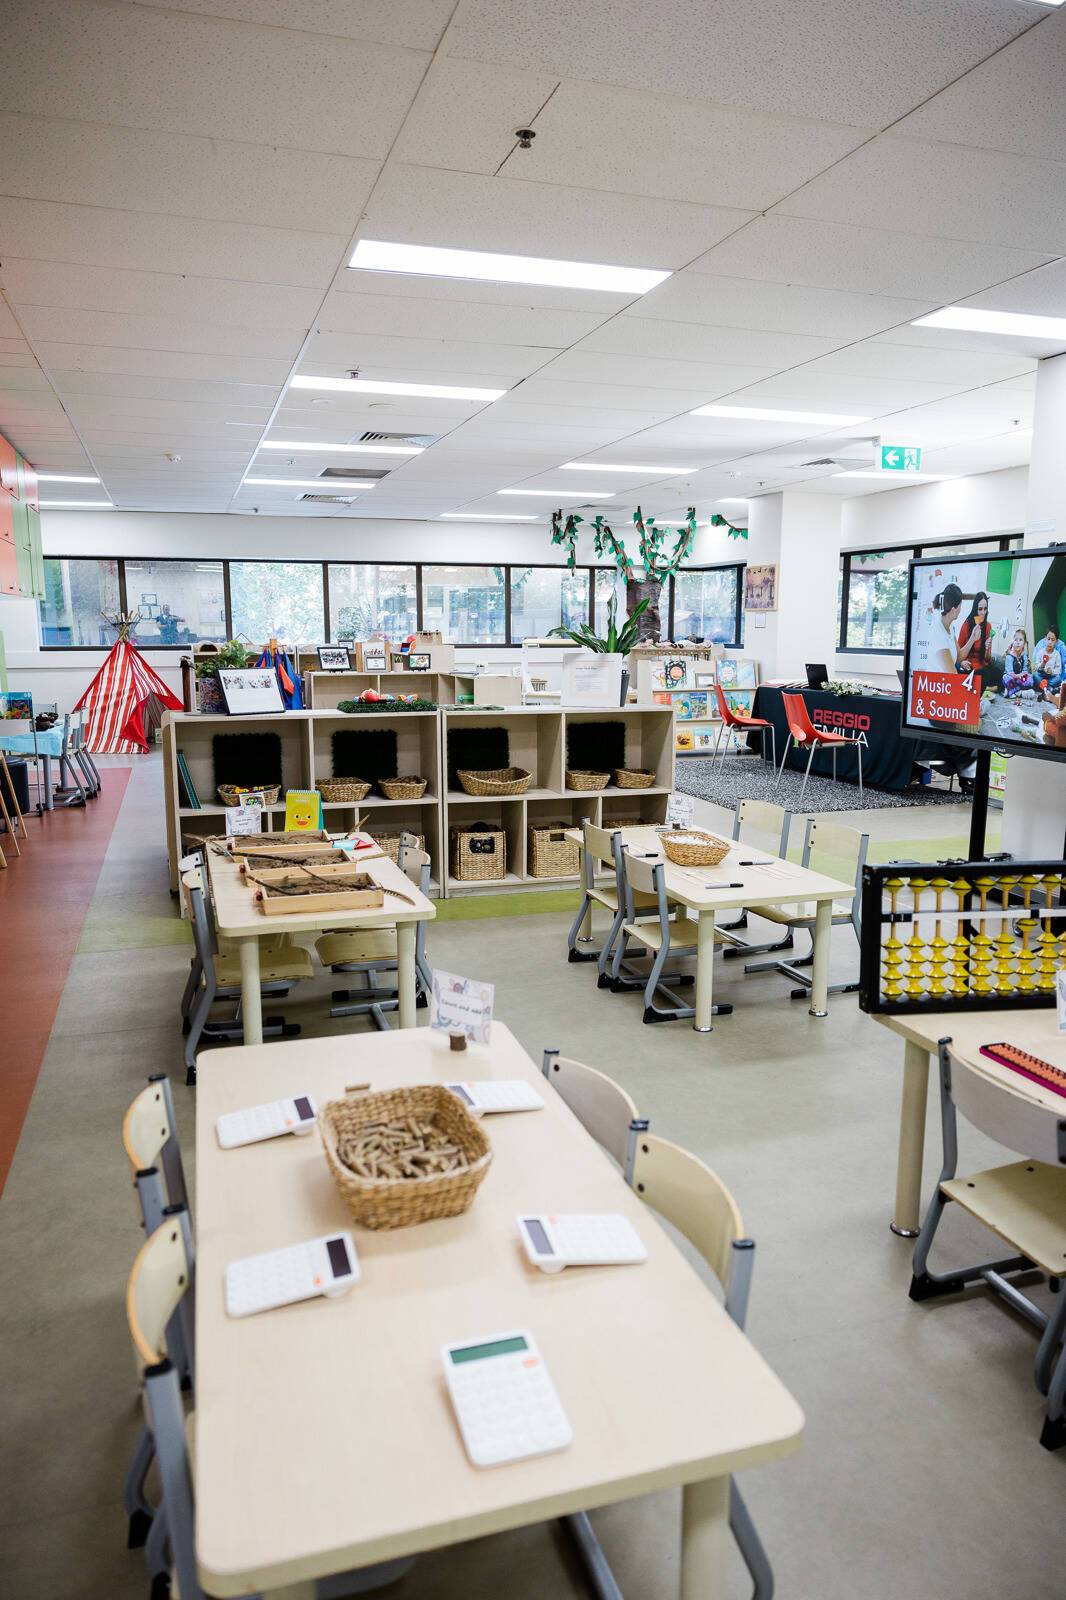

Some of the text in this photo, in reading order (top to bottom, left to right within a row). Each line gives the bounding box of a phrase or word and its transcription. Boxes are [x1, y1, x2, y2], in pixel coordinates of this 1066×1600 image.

[917, 675, 952, 694] Music
[961, 669, 977, 694] 4.
[813, 708, 871, 731] REGGIO
[916, 698, 968, 720] & Sound
